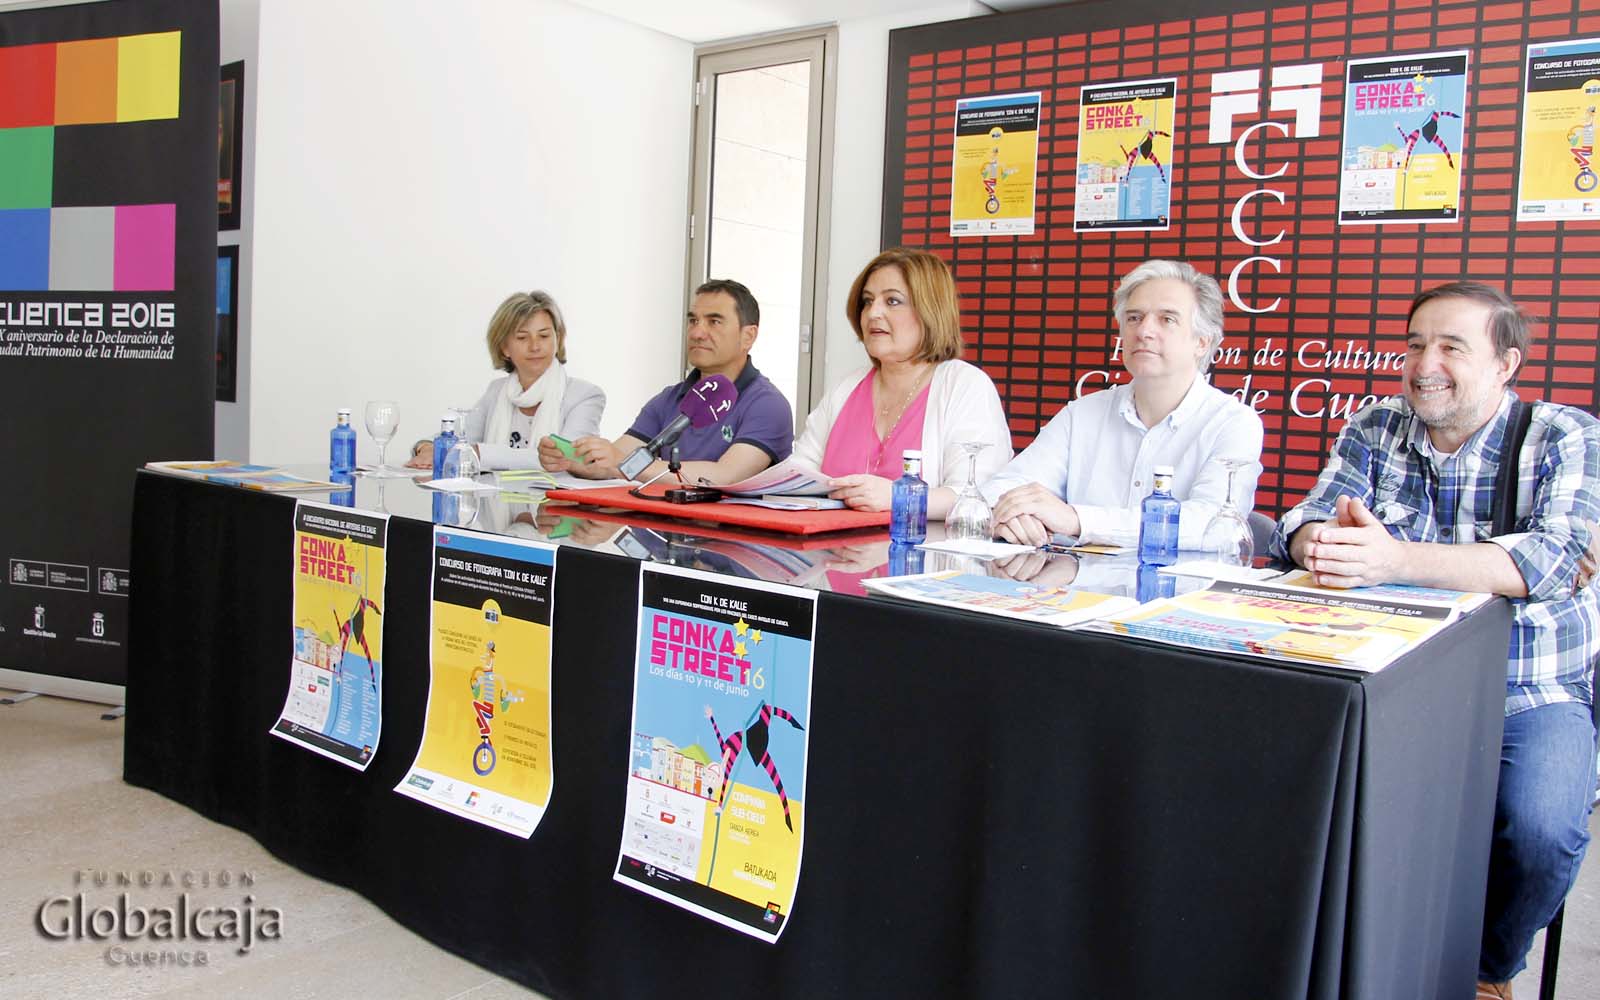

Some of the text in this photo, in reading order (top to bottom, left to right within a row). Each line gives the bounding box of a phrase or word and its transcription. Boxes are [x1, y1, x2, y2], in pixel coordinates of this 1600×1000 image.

[1356, 82, 1414, 97] CONKA
[1086, 104, 1134, 119] CONKA
[1356, 94, 1426, 110] STREET
[1086, 115, 1143, 130] STREET
[112, 302, 175, 328] 2016
[7, 330, 64, 344] aniversario
[66, 330, 80, 344] de
[82, 330, 92, 344] la
[96, 330, 157, 345] Declaración
[160, 331, 174, 345] de
[25, 343, 82, 358] Patrimonio
[84, 344, 98, 358] de
[100, 344, 112, 358] la
[113, 345, 174, 360] Humanidad
[1254, 338, 1283, 366] de
[300, 535, 346, 564] CONKA
[300, 555, 355, 585] STREET
[440, 557, 464, 570] CONCURSO
[464, 562, 472, 572] DE
[516, 572, 521, 581] K
[522, 572, 530, 583] DE
[700, 594, 748, 612] CON K DE KALLE
[652, 614, 738, 656] CONKA
[650, 640, 766, 690] STREET 16
[650, 665, 750, 697] Los días 10 y 11 de junio
[744, 862, 777, 882] BATUKADA
